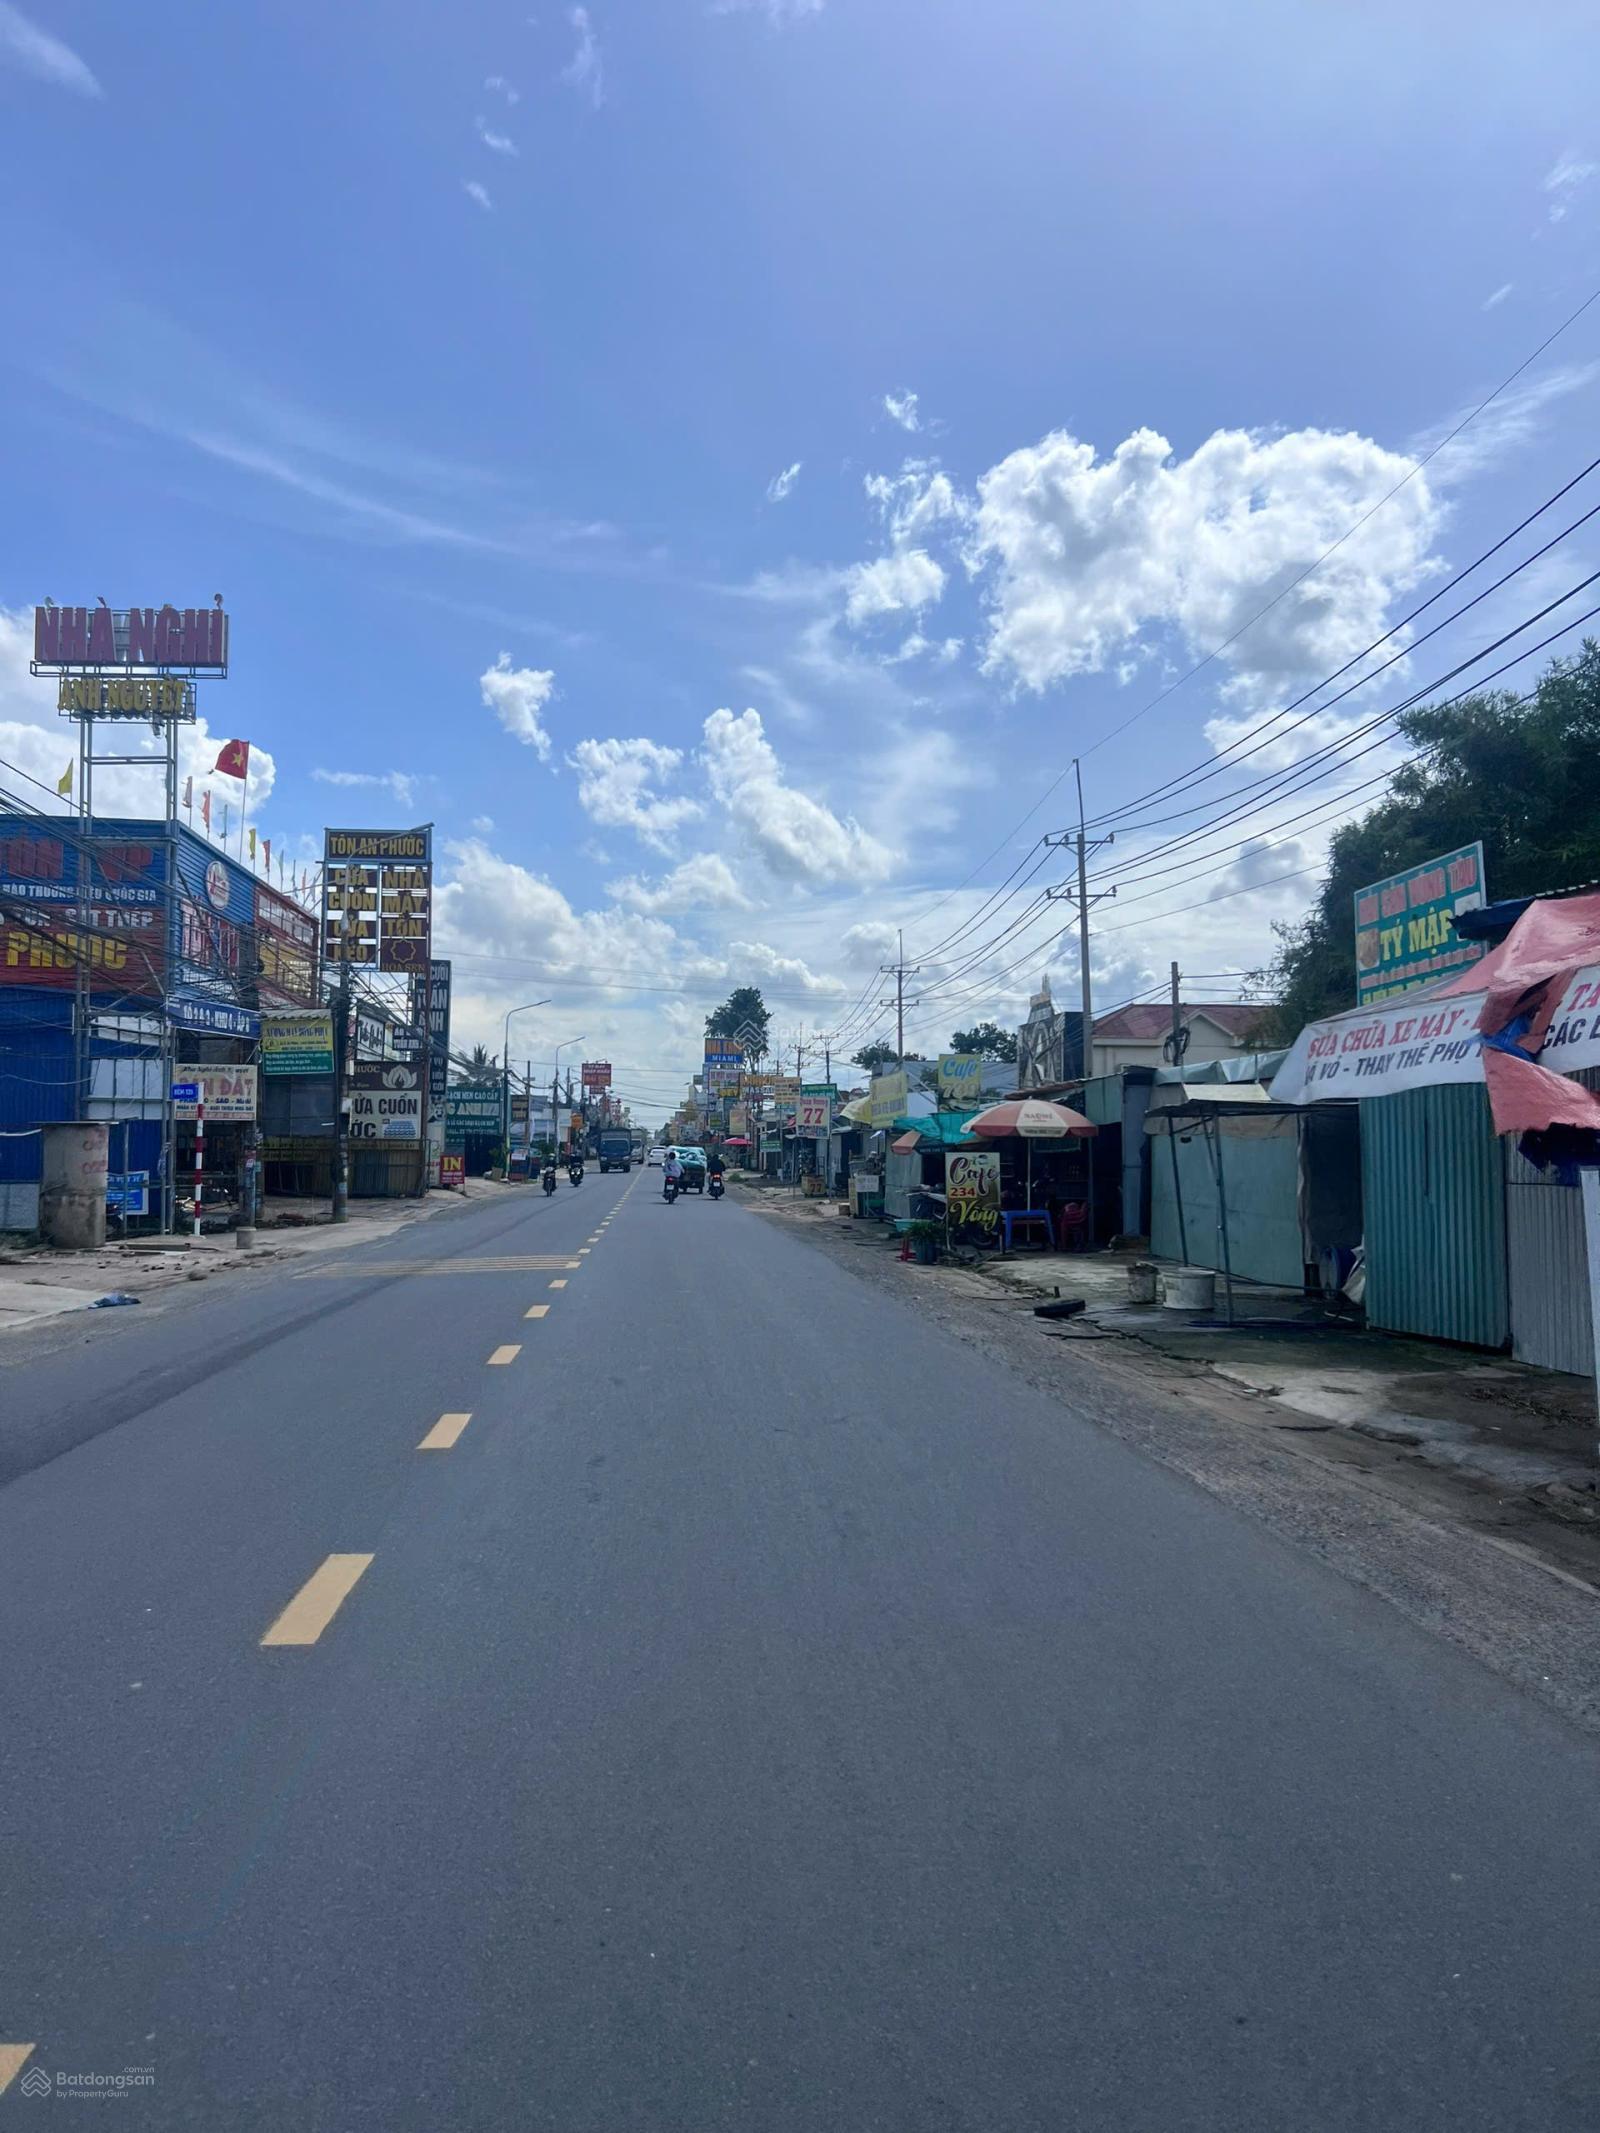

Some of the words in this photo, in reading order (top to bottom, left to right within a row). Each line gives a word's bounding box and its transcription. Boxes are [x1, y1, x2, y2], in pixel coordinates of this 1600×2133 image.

[35, 596, 116, 665] NHÀ
[129, 594, 225, 664] NGHỈ
[331, 834, 355, 855] TÔN
[359, 837, 377, 855] AN
[379, 835, 425, 856] PHƯỚC
[384, 867, 425, 889] NHÀ
[137, 889, 157, 901] GIA
[328, 888, 376, 910] CUỐN
[384, 893, 424, 914] MÁY
[385, 915, 422, 937] TÔN
[1389, 1020, 1414, 1045] XE
[1414, 1004, 1465, 1041] MÁY
[1542, 1016, 1587, 1050] CÁC
[355, 1063, 381, 1073] HƯỚC
[1355, 1052, 1396, 1077] THAY
[1398, 1039, 1432, 1070] THẾ
[354, 1093, 373, 1115] ỬA
[379, 1092, 417, 1114] CUỐN
[474, 1091, 487, 1100] CAO
[804, 1108, 824, 1124] 77
[351, 1119, 377, 1138] ỚC
[443, 1156, 462, 1171] IN
[950, 1187, 976, 1197] 234
